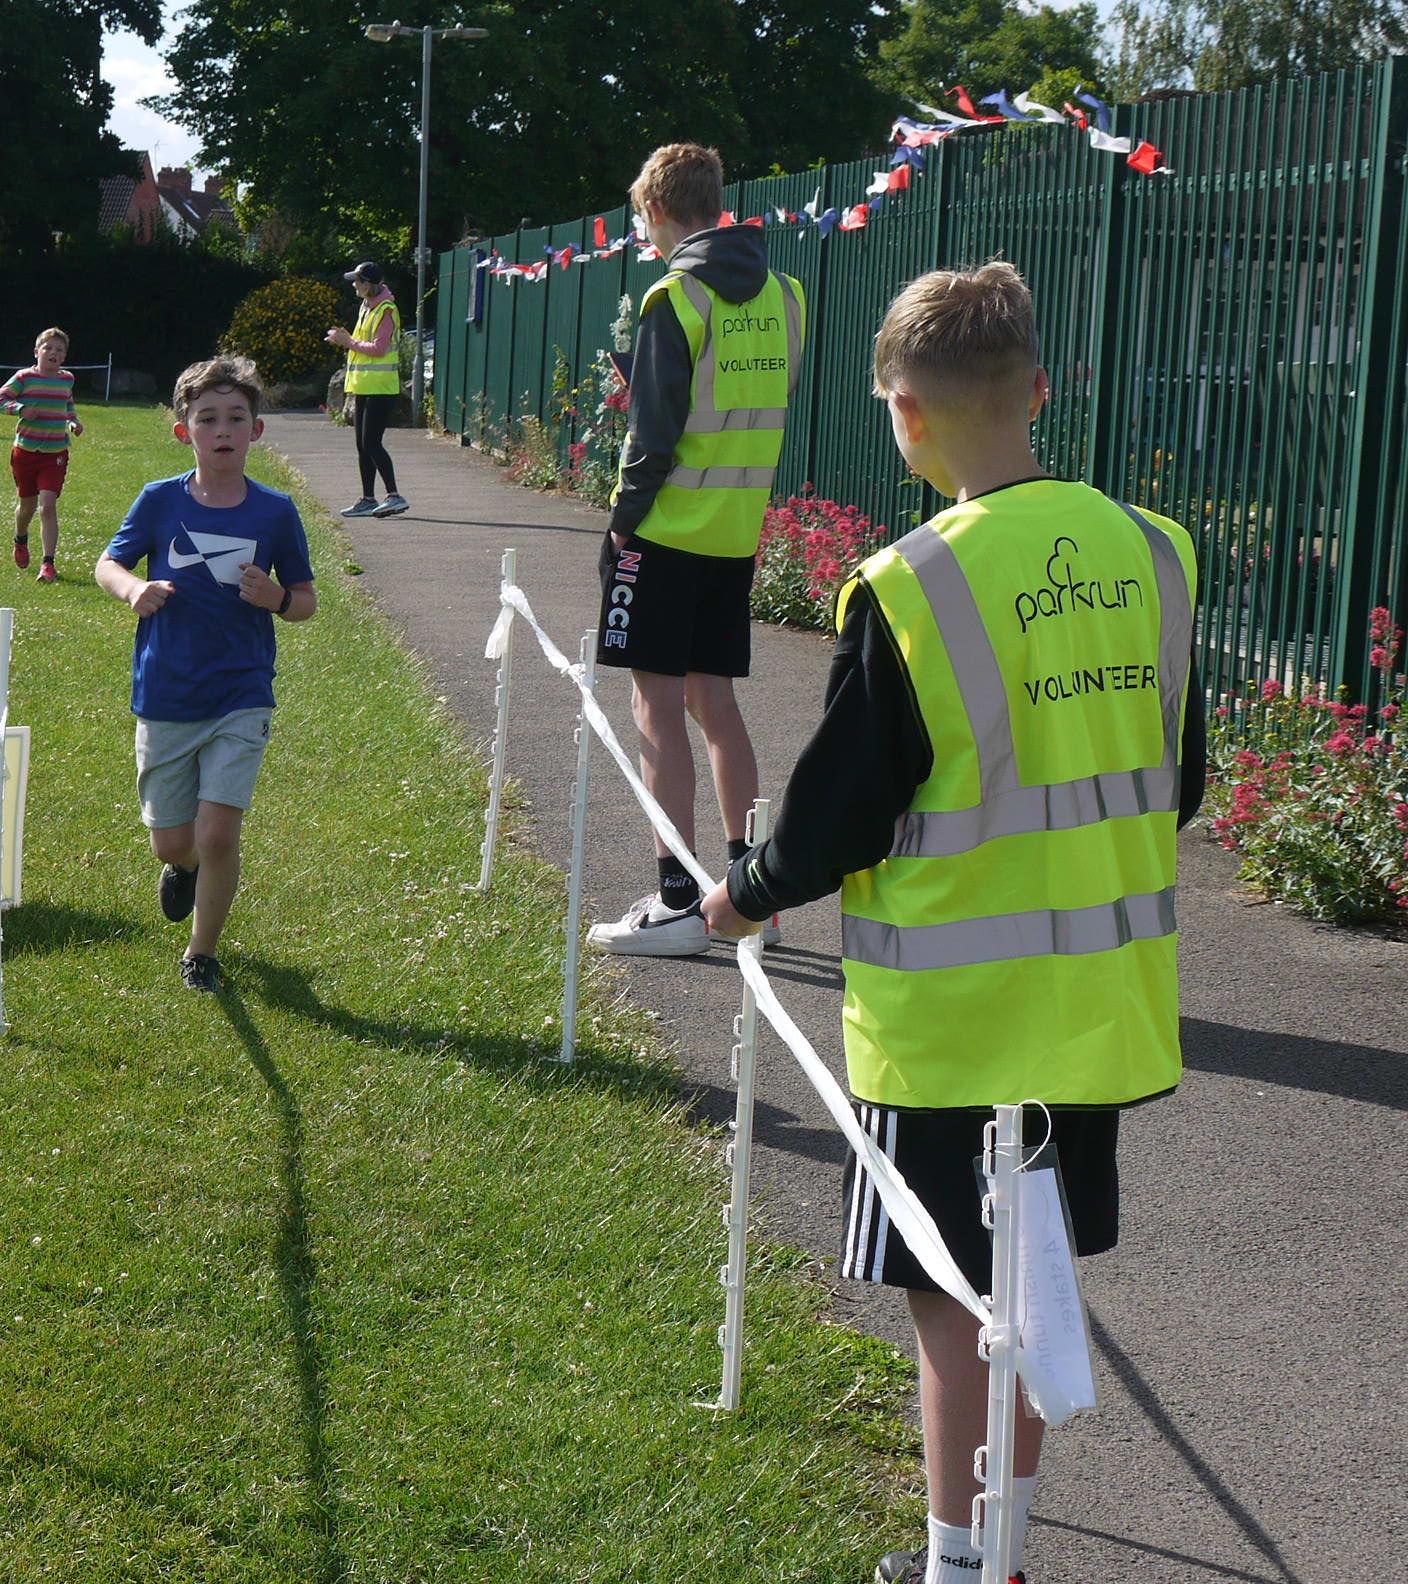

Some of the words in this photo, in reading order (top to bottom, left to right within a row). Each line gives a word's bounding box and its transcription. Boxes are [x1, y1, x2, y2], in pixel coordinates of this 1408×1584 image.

[605, 550, 642, 649] NICCE
[1015, 537, 1143, 632] parkrun
[940, 1554, 983, 1570] adid
